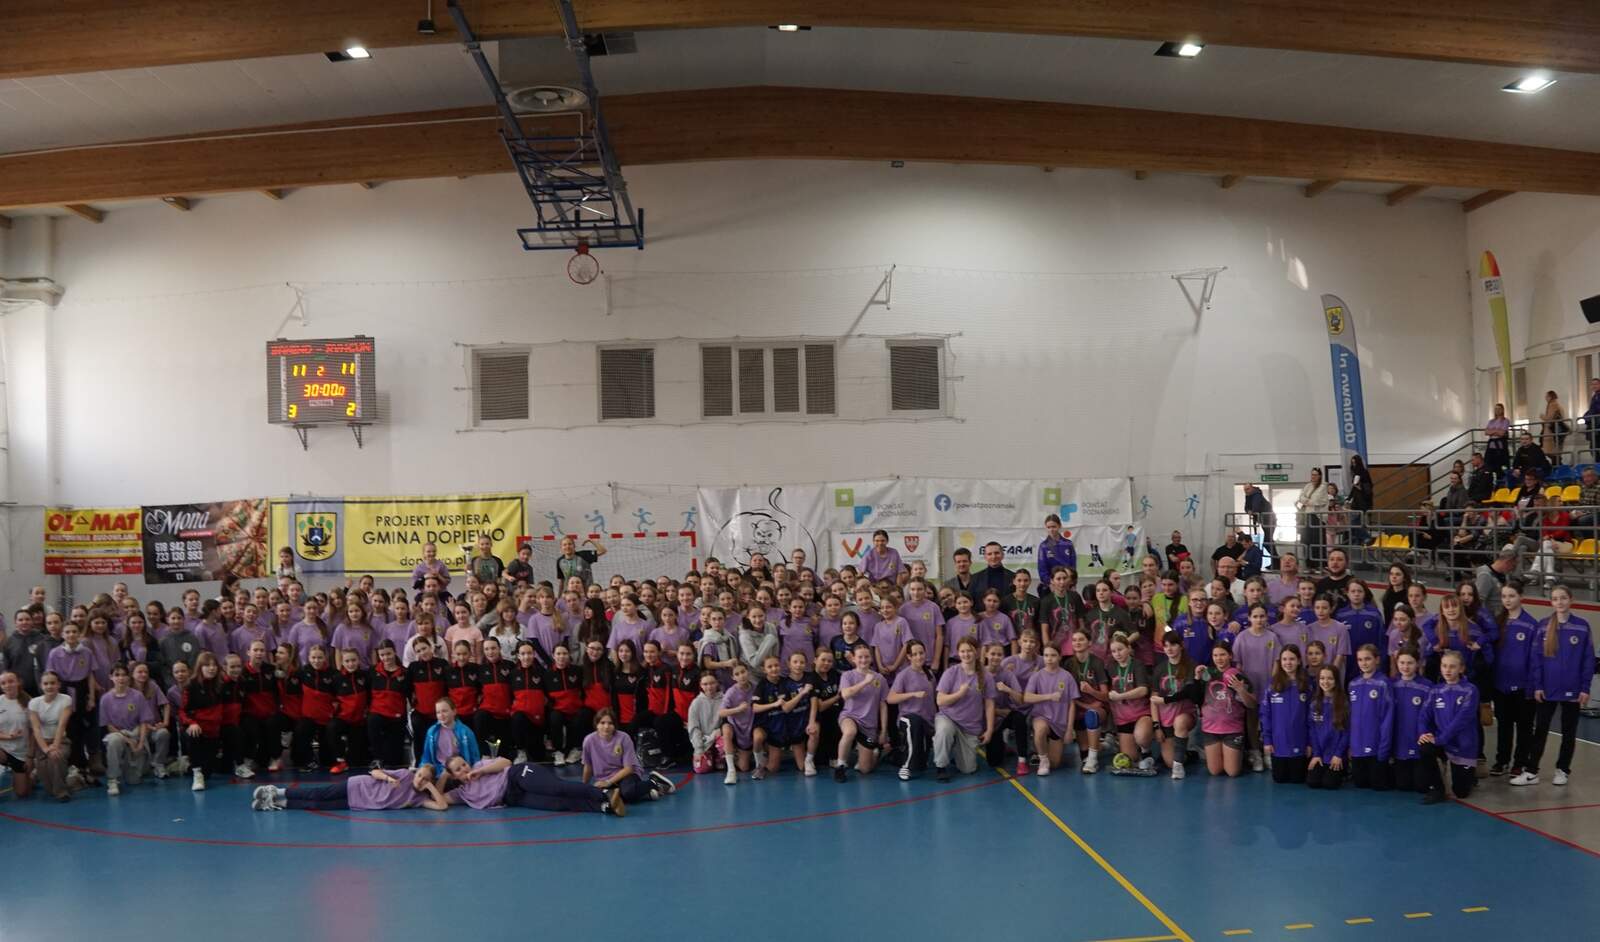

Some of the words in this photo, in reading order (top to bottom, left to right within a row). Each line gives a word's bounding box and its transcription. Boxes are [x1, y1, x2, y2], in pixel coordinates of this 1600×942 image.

[292, 364, 307, 377] 11
[316, 366, 325, 377] 2
[341, 362, 355, 375] 11
[288, 404, 298, 418] 3
[346, 402, 356, 417] 2
[160, 511, 210, 535] Mona
[376, 515, 430, 527] PROJEKT
[435, 513, 491, 526] WSPIERA
[362, 530, 421, 545] GMINA
[979, 545, 1033, 555] BFARM
[156, 552, 169, 562] 733
[400, 554, 466, 567] dopo.pl
